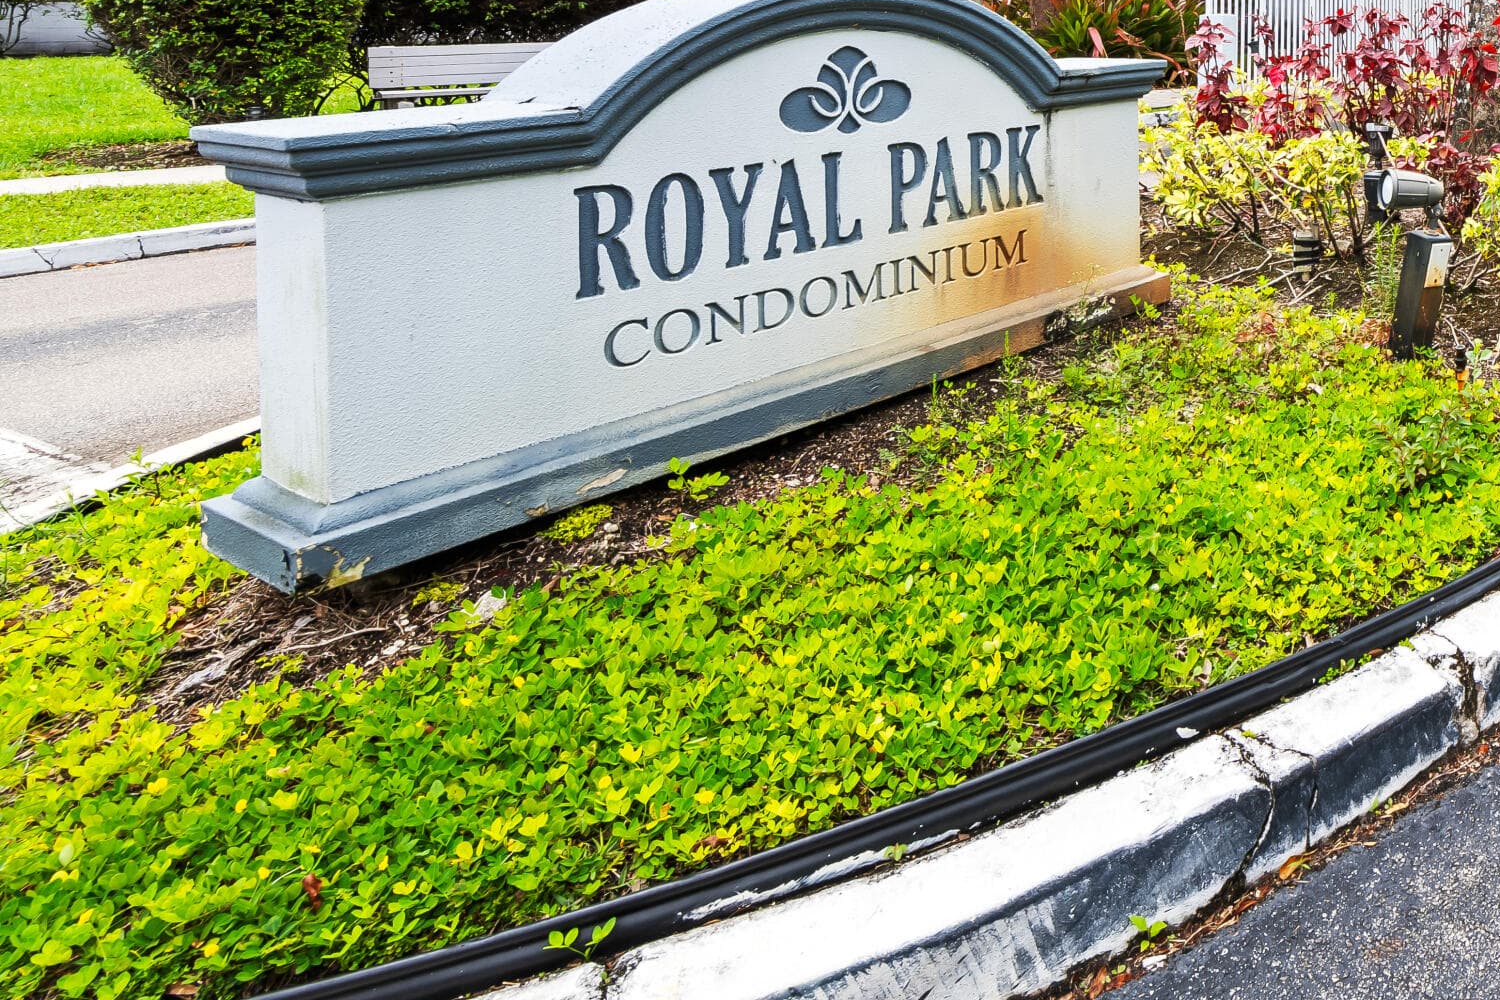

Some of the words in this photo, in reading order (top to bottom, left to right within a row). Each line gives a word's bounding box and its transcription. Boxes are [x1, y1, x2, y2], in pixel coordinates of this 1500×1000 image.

[574, 151, 863, 300] ROYAL
[887, 125, 1043, 234] PARK
[603, 229, 1028, 368] CONDOMINIUM
